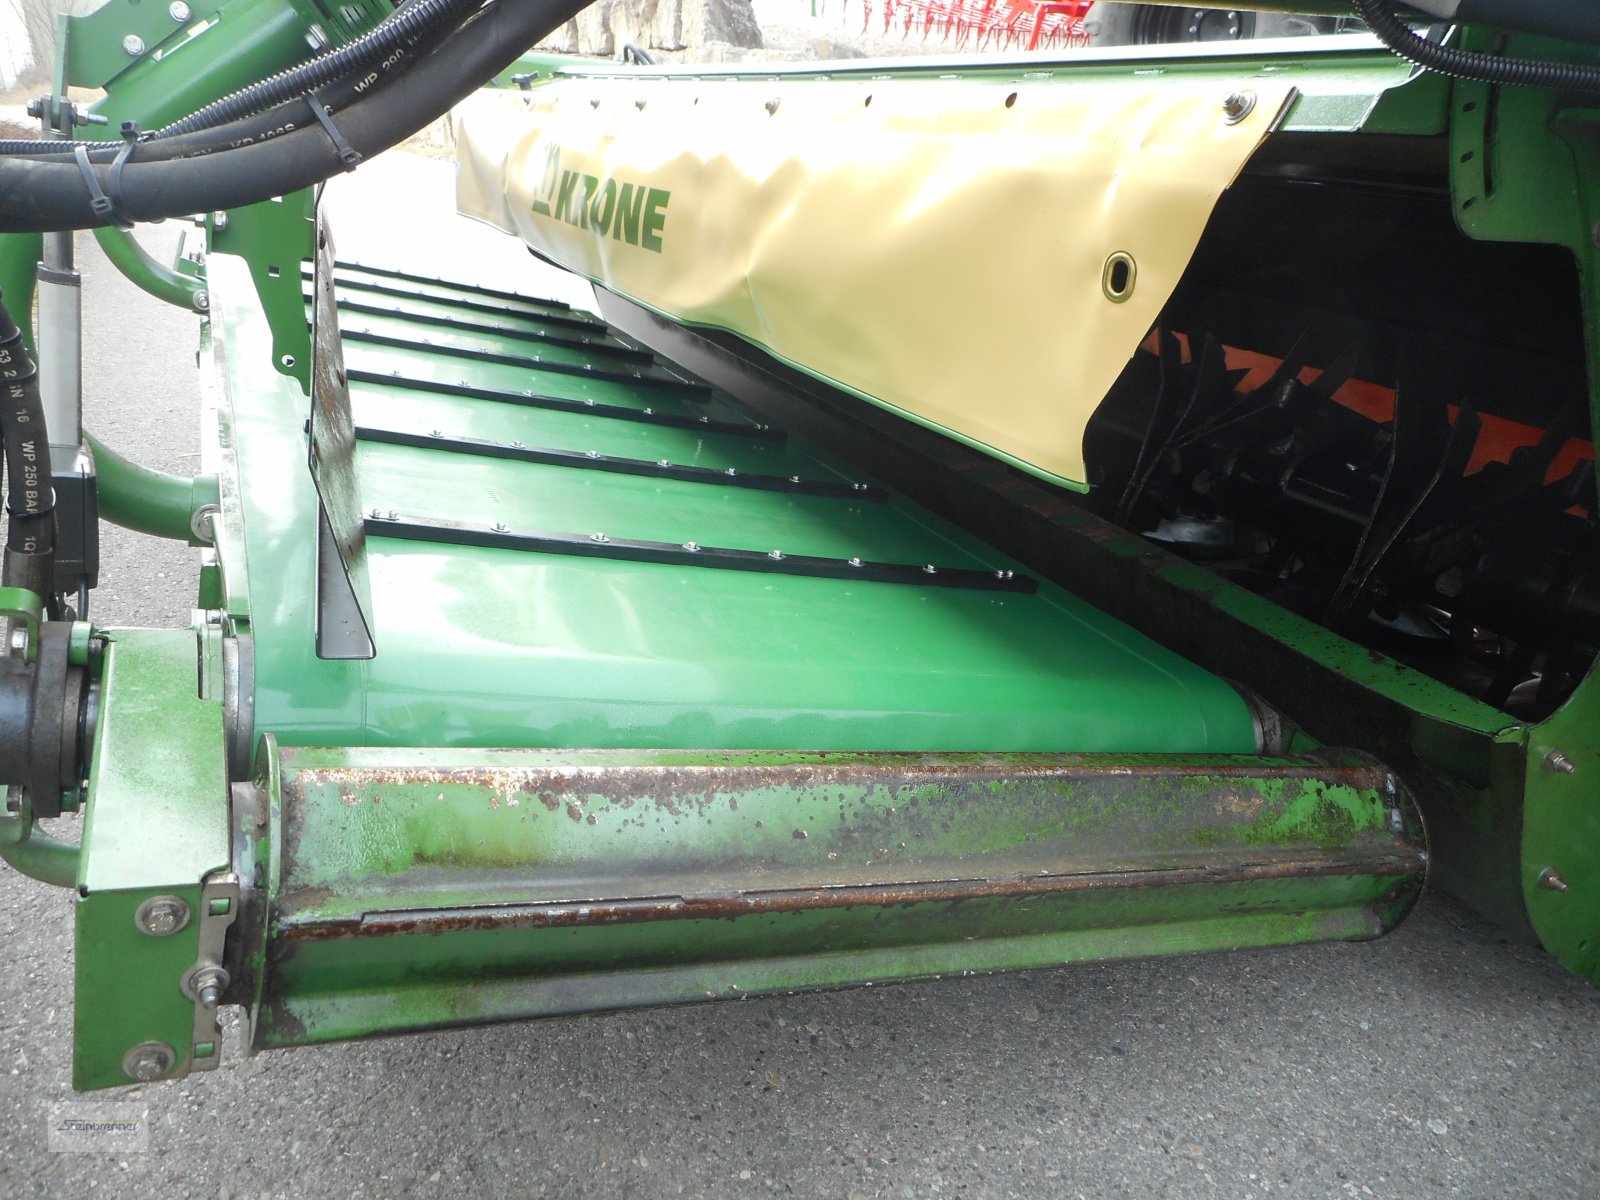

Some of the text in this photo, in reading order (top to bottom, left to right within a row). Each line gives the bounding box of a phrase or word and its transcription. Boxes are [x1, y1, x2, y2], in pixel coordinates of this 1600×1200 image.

[554, 170, 671, 254] KRONE
[16, 408, 30, 423] 16
[22, 440, 36, 462] WP
[24, 465, 38, 487] 250
